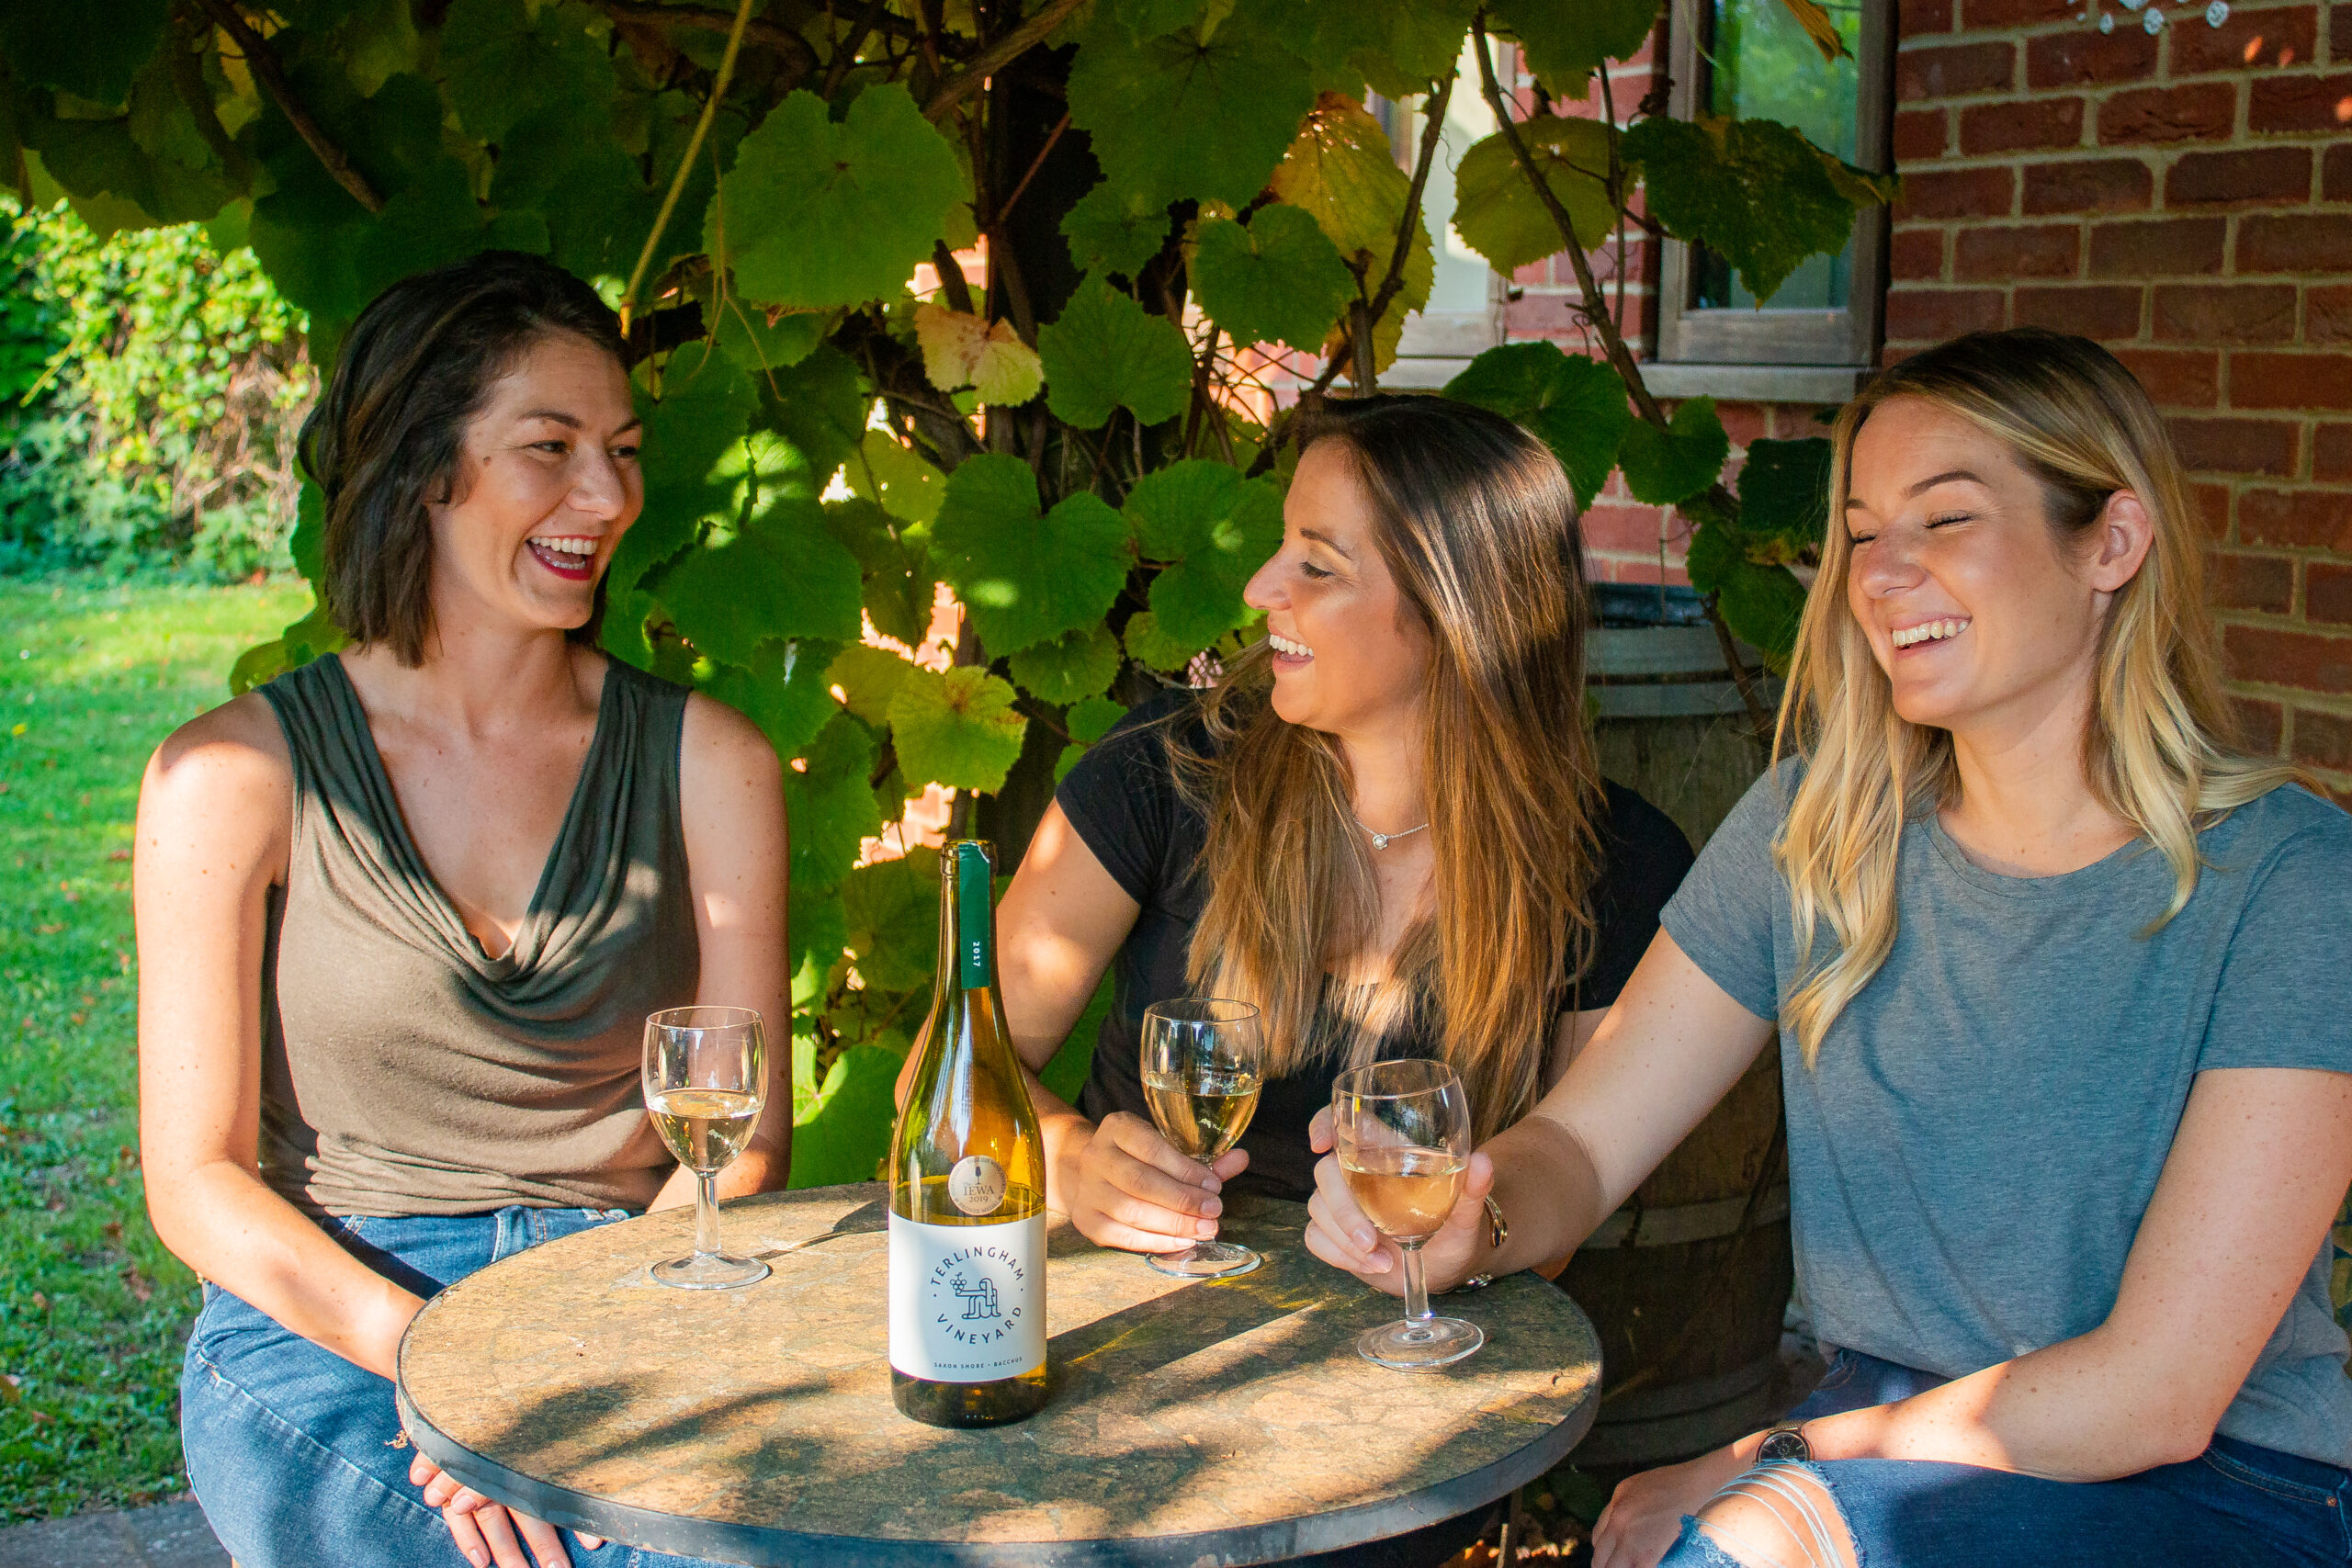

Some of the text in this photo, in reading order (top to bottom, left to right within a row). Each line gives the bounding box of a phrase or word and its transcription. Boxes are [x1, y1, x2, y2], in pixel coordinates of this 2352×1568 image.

[964, 1185, 994, 1196] IEWA
[969, 1195, 989, 1203] 2019
[930, 1246, 1023, 1285] TERLINGHAM
[937, 1306, 1022, 1345] VINEYARD
[933, 1361, 957, 1370] SAXON
[993, 1355, 1023, 1368] BACCHUS
